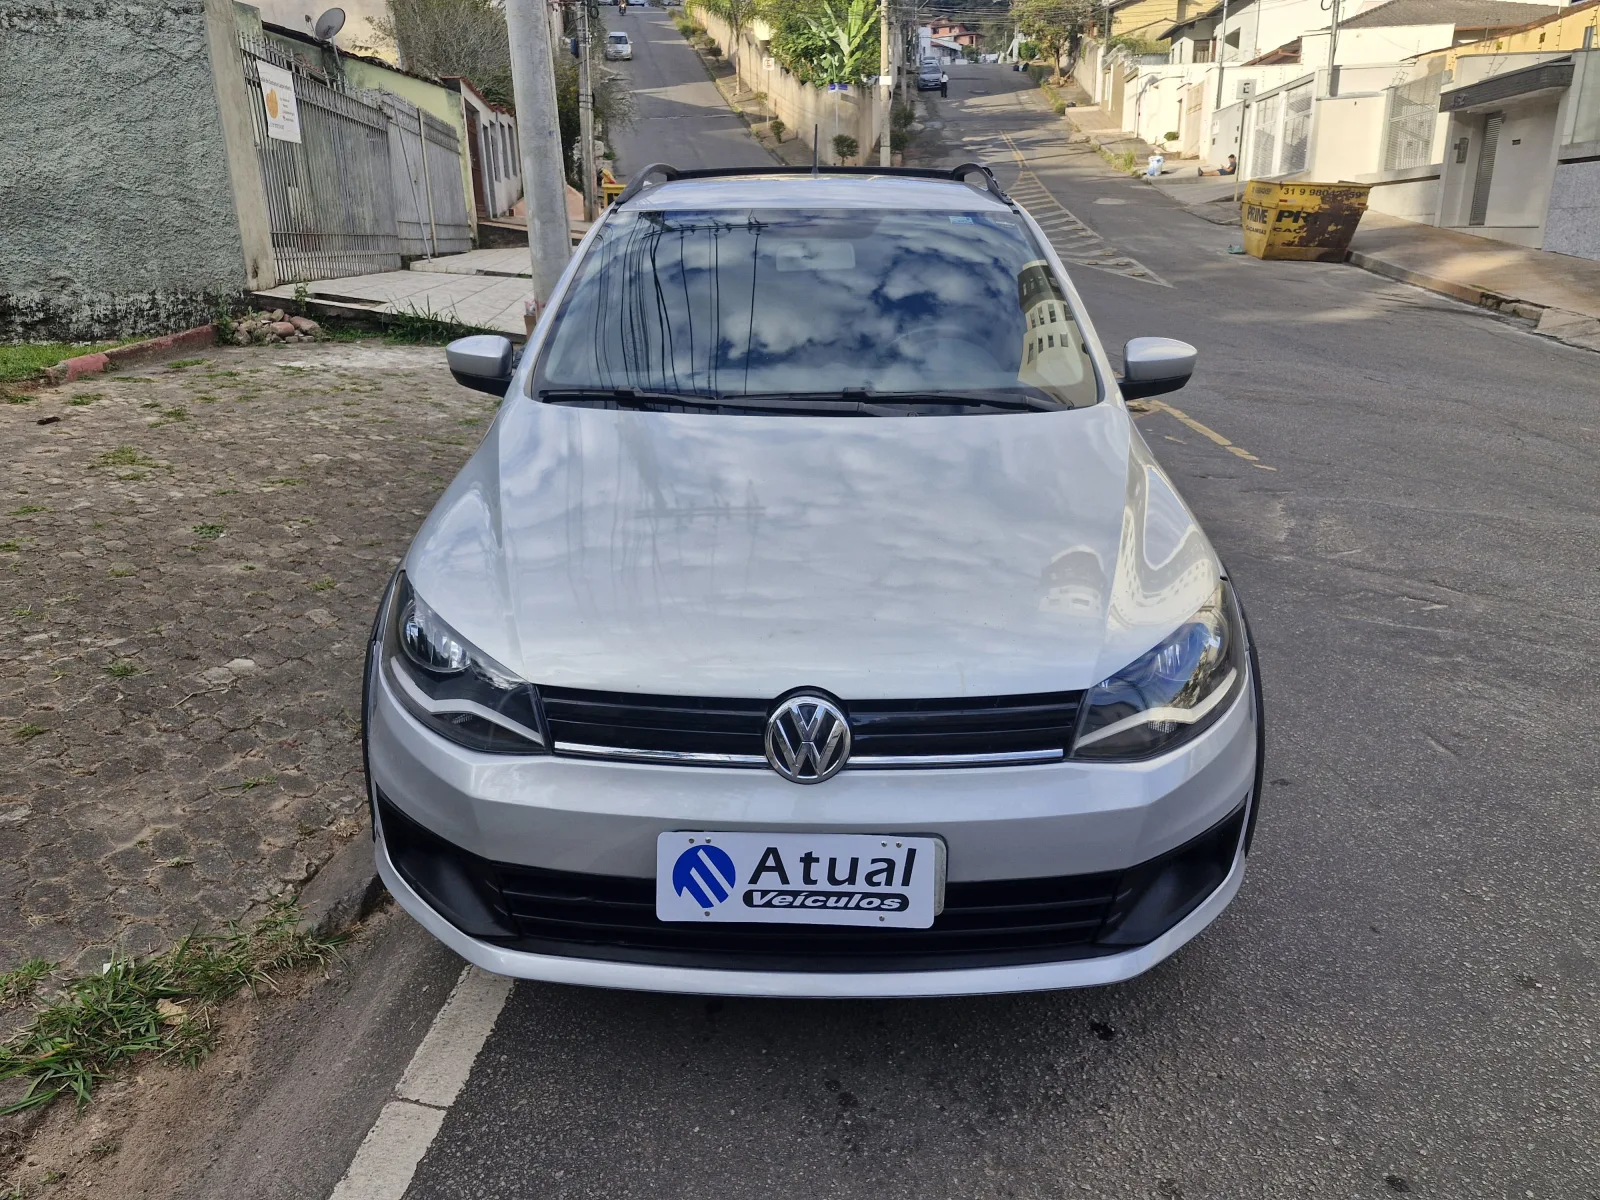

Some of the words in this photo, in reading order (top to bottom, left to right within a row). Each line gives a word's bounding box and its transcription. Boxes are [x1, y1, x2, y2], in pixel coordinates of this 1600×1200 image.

[1284, 187, 1295, 195] 31
[1246, 205, 1268, 224] PRIME
[747, 846, 918, 888] Atual
[752, 891, 903, 910] Veículos
